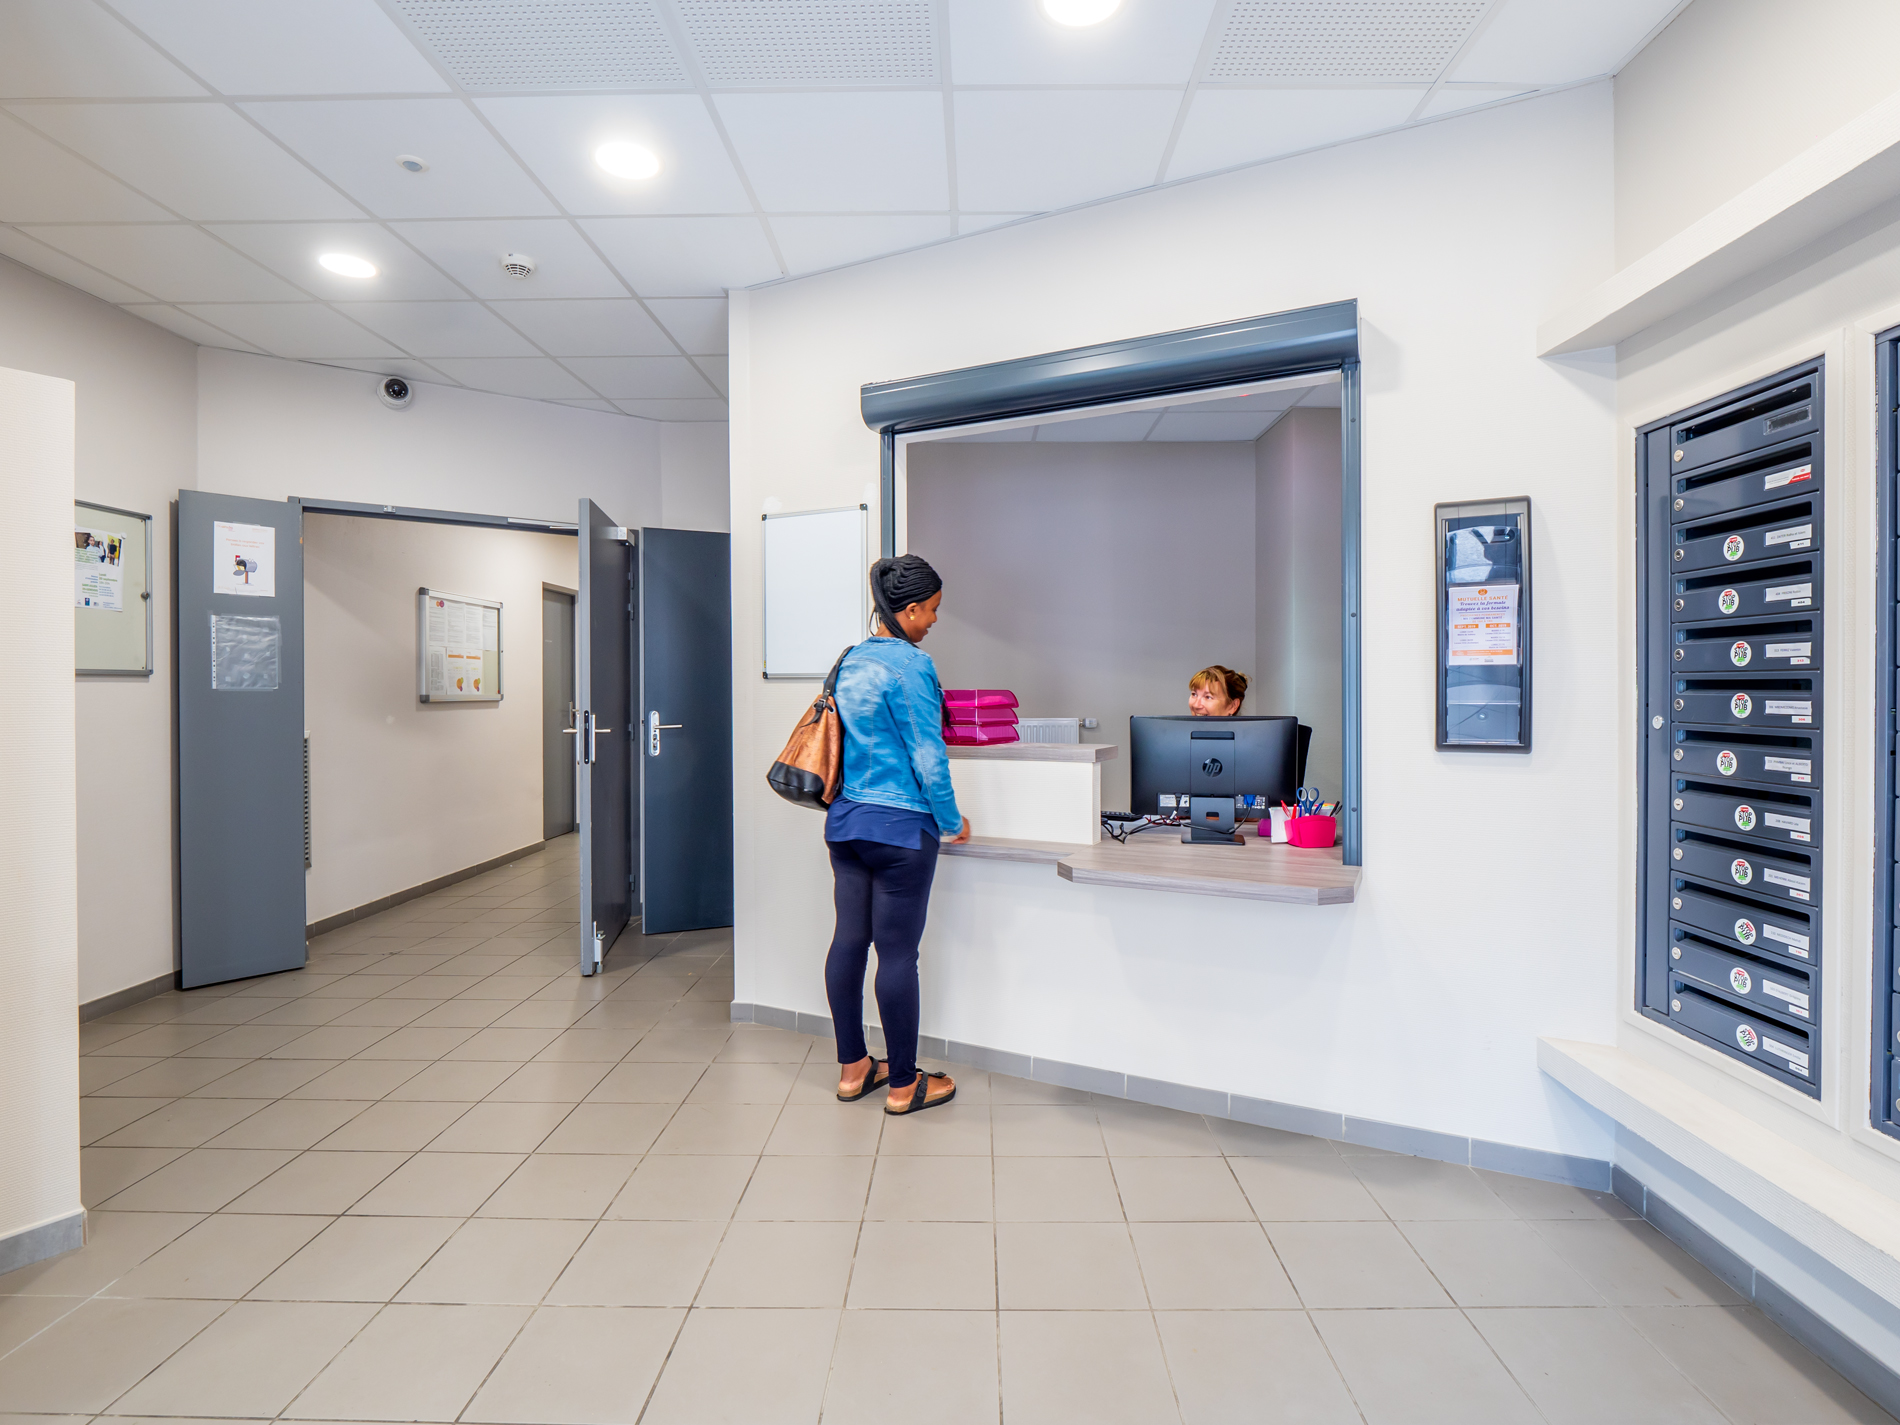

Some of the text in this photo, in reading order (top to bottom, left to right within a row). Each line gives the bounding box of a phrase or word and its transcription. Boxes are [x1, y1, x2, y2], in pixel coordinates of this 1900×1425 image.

[1203, 758, 1222, 777] hp
[1735, 870, 1748, 878] PUB
[1738, 924, 1750, 940] PUB
[1742, 922, 1753, 937] STOP
[1734, 972, 1748, 981] STOP
[1734, 977, 1747, 988] PUB
[1740, 1030, 1752, 1047] PUB
[1744, 1028, 1755, 1045] STOP
